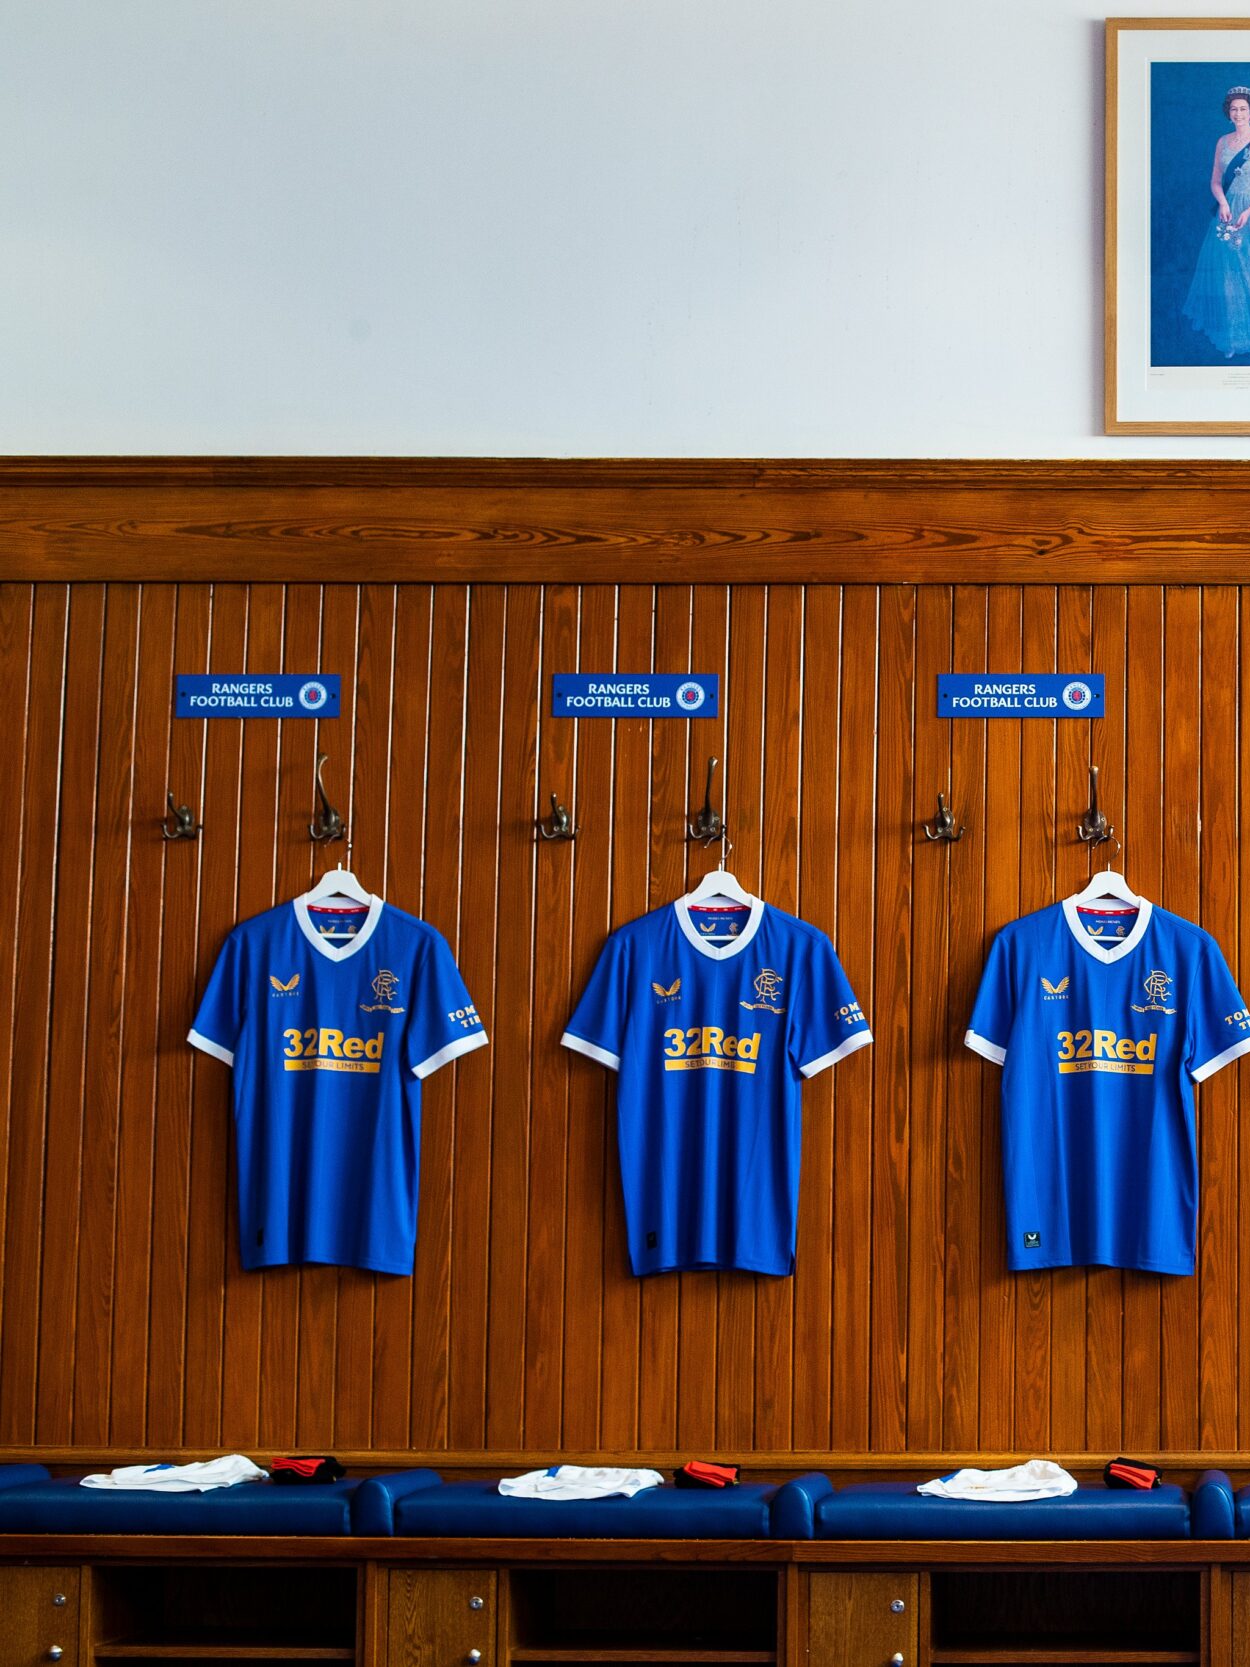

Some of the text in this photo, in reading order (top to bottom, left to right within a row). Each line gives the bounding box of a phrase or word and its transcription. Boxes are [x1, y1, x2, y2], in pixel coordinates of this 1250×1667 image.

[211, 683, 273, 694] RANGERS
[588, 683, 650, 695] RANGERS
[973, 684, 1036, 695] RANGERS
[190, 695, 258, 708] FOOTBALL
[260, 696, 294, 708] CLUB
[566, 695, 635, 708] FOOTBALL
[637, 696, 671, 708] CLUB
[952, 696, 1058, 709] FOOTBALL CLUB
[283, 1028, 384, 1059] 32Red
[664, 1026, 761, 1060] 32Red
[1057, 1029, 1157, 1061] 32Red
[336, 1061, 365, 1071] LIMITS
[1110, 1063, 1136, 1072] LIMITS
